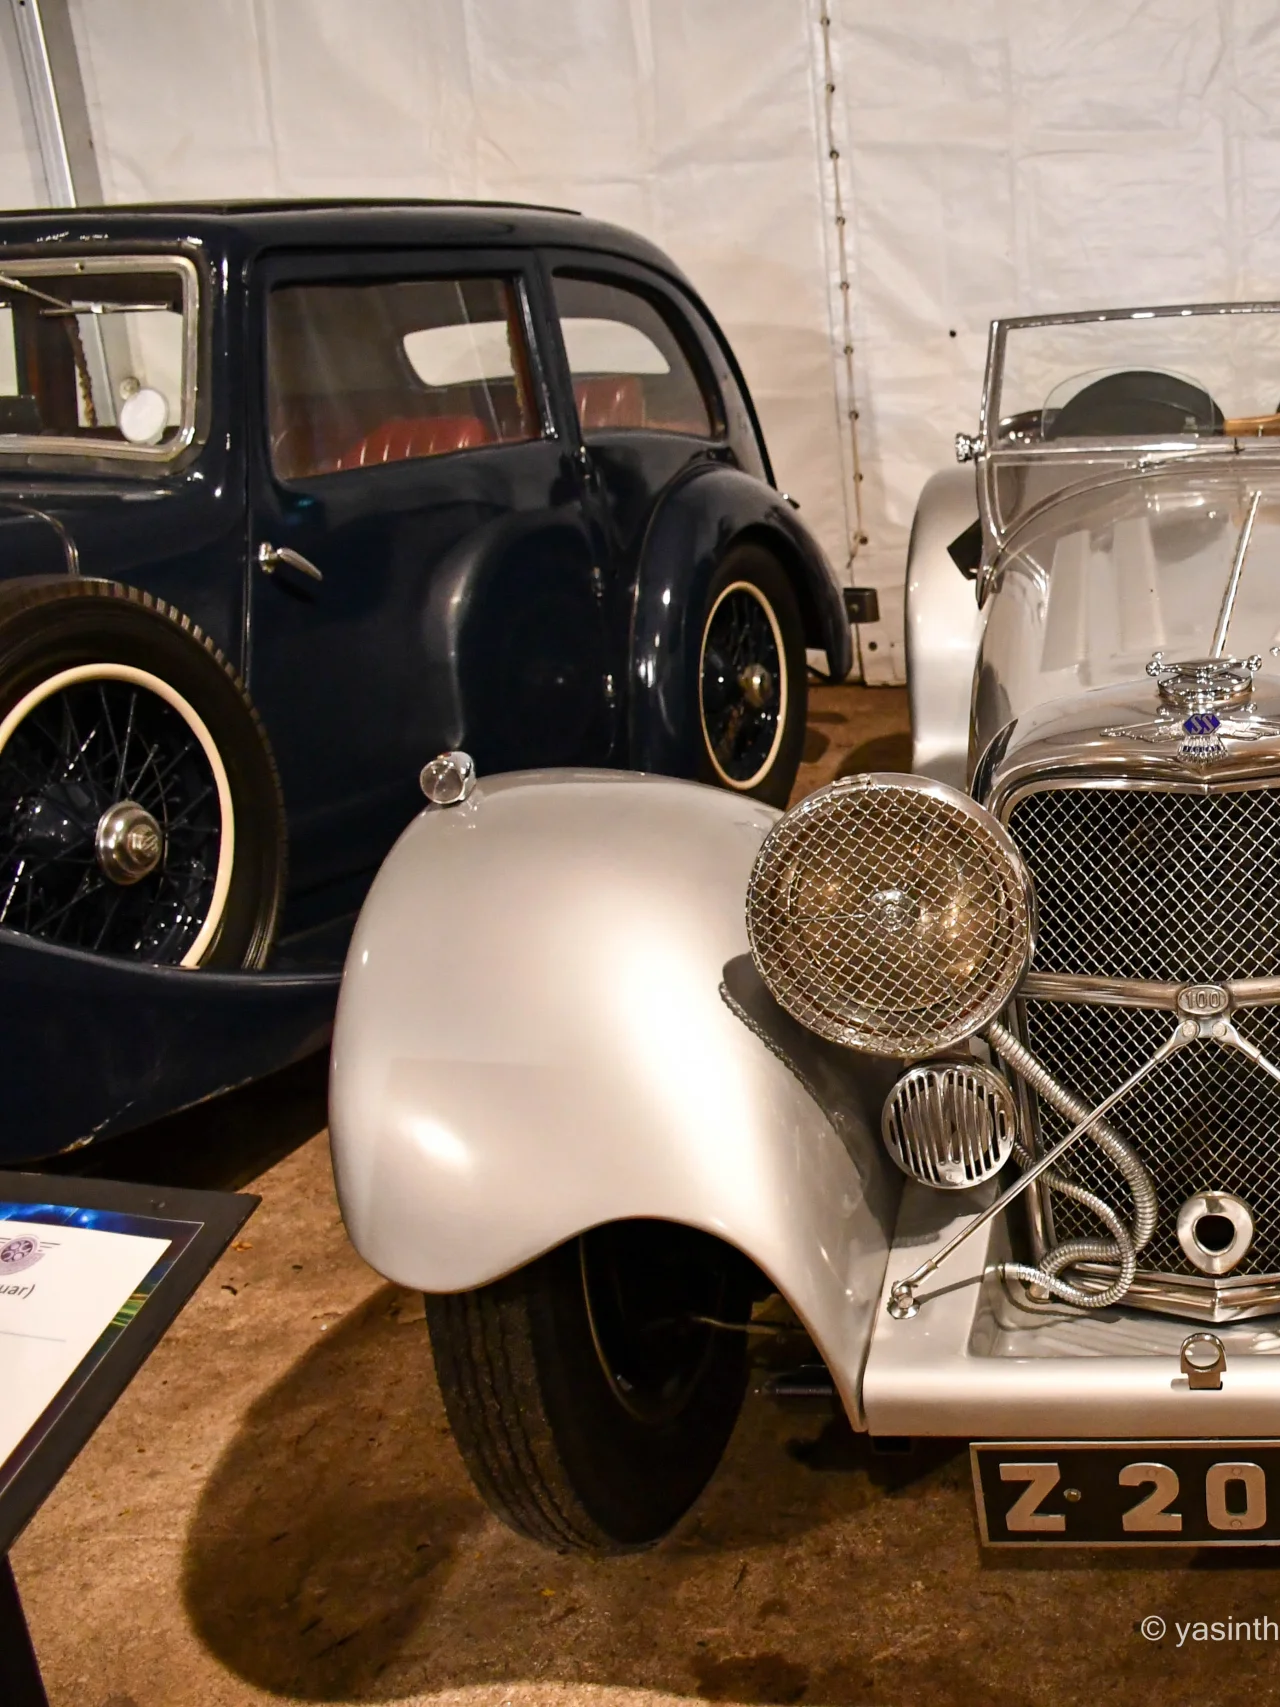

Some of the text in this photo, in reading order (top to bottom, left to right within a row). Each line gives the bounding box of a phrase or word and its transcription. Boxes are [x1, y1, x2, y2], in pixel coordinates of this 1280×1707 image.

[1191, 714, 1214, 735] SS
[1186, 991, 1221, 1009] 100
[999, 1462, 1066, 1531] Z
